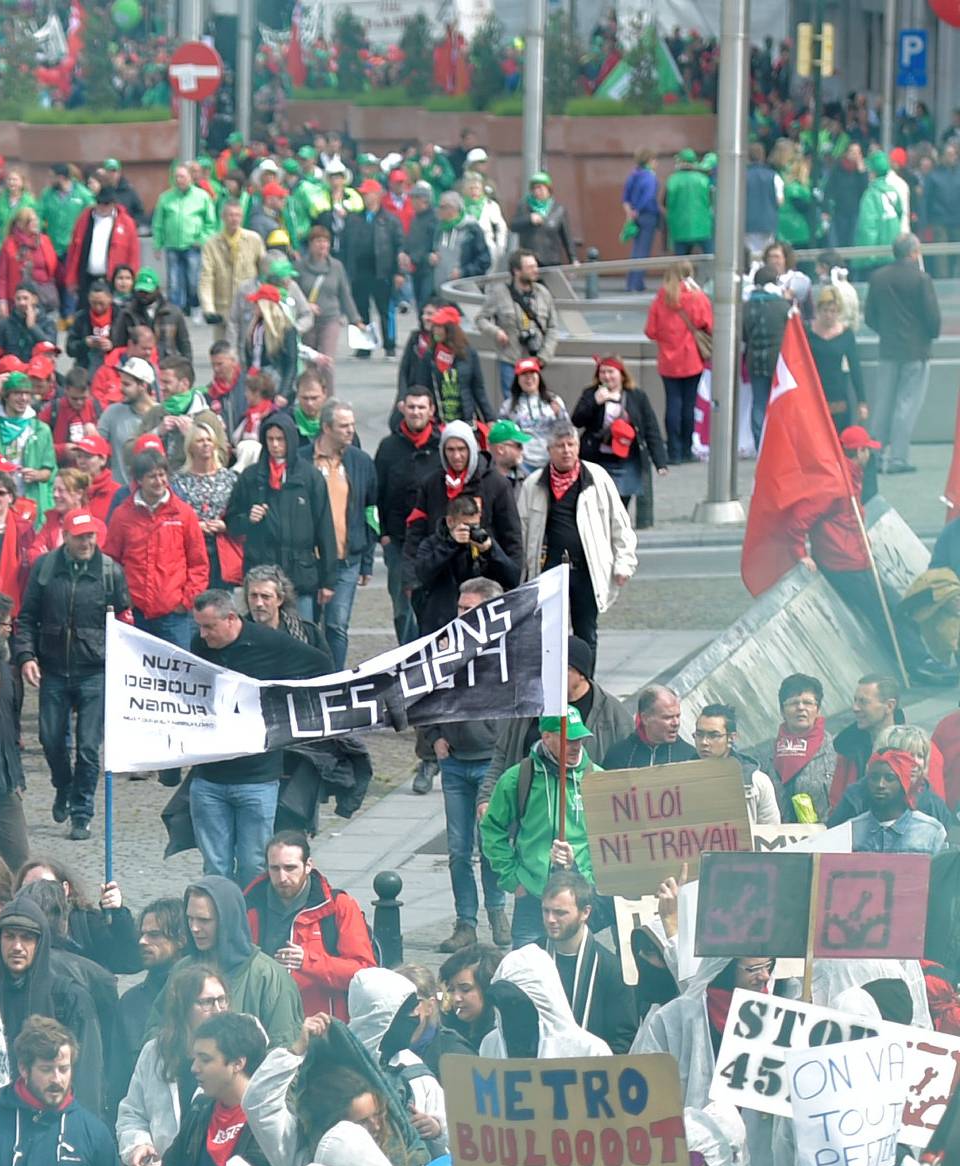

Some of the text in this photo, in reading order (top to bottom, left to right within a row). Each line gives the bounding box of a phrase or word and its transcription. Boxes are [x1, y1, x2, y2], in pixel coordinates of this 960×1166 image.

[902, 35, 924, 66] P
[142, 653, 198, 673] NUIT
[287, 683, 378, 738] LES
[472, 1066, 649, 1122] METRO
[792, 1042, 905, 1101] ON VA
[808, 1101, 904, 1143] TOUT
